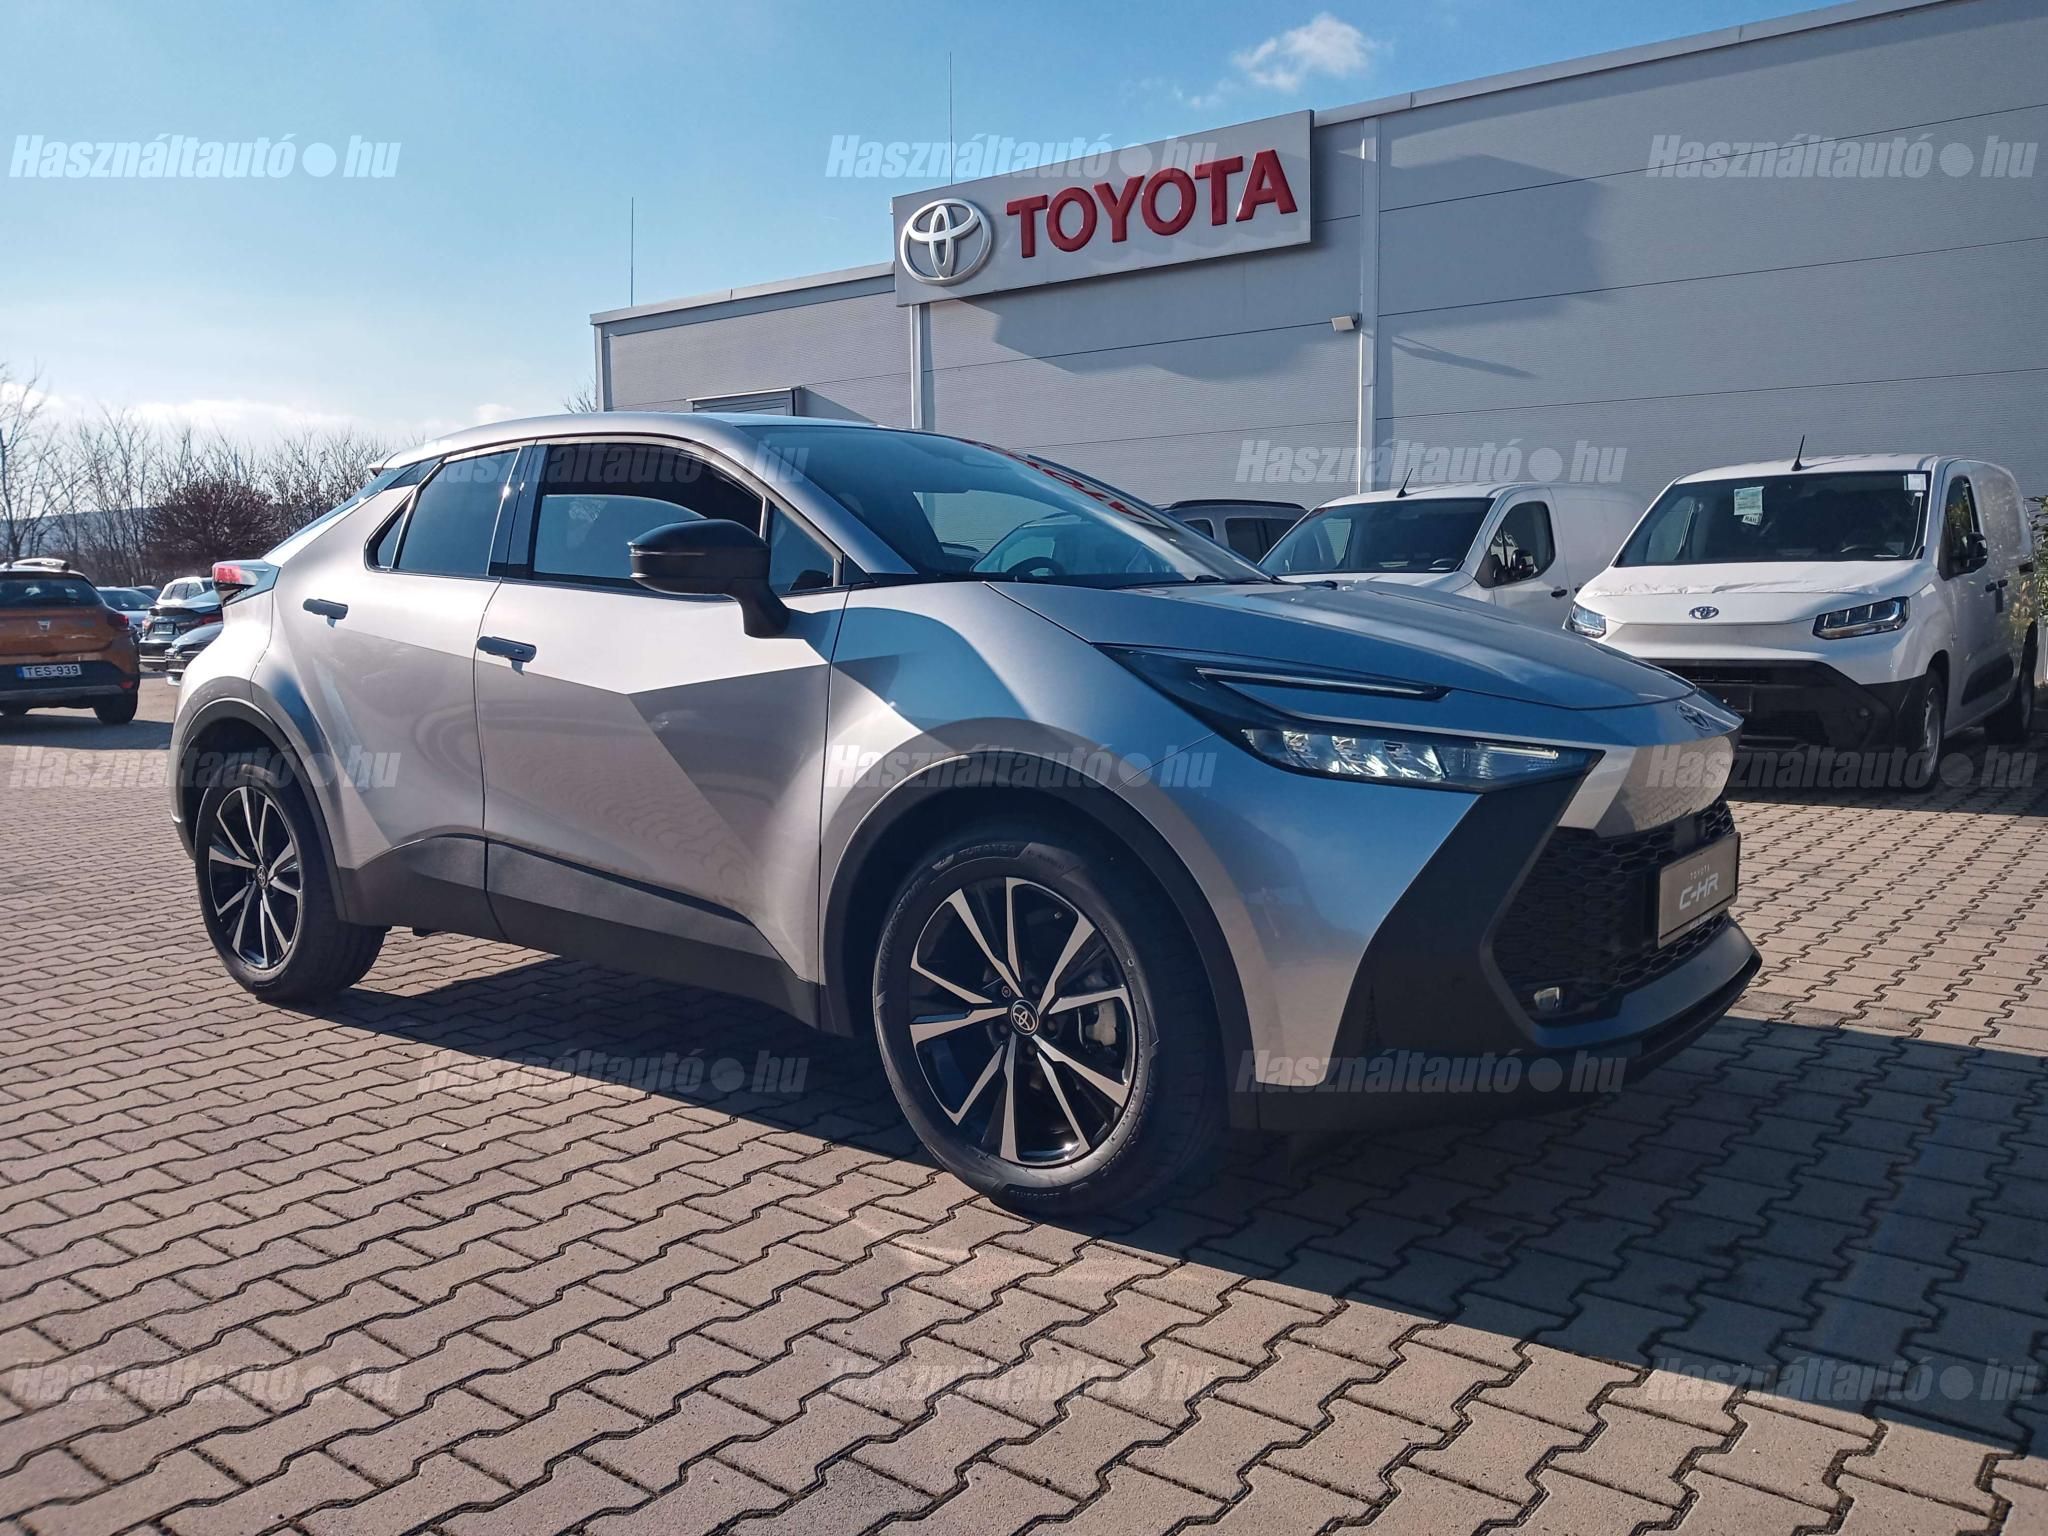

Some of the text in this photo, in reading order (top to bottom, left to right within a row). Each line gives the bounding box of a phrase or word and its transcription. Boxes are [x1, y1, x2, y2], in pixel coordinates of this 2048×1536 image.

[1006, 149, 1297, 258] TOYOTA
[26, 665, 79, 676] TES-939
[1680, 872, 1719, 910] C-HR
